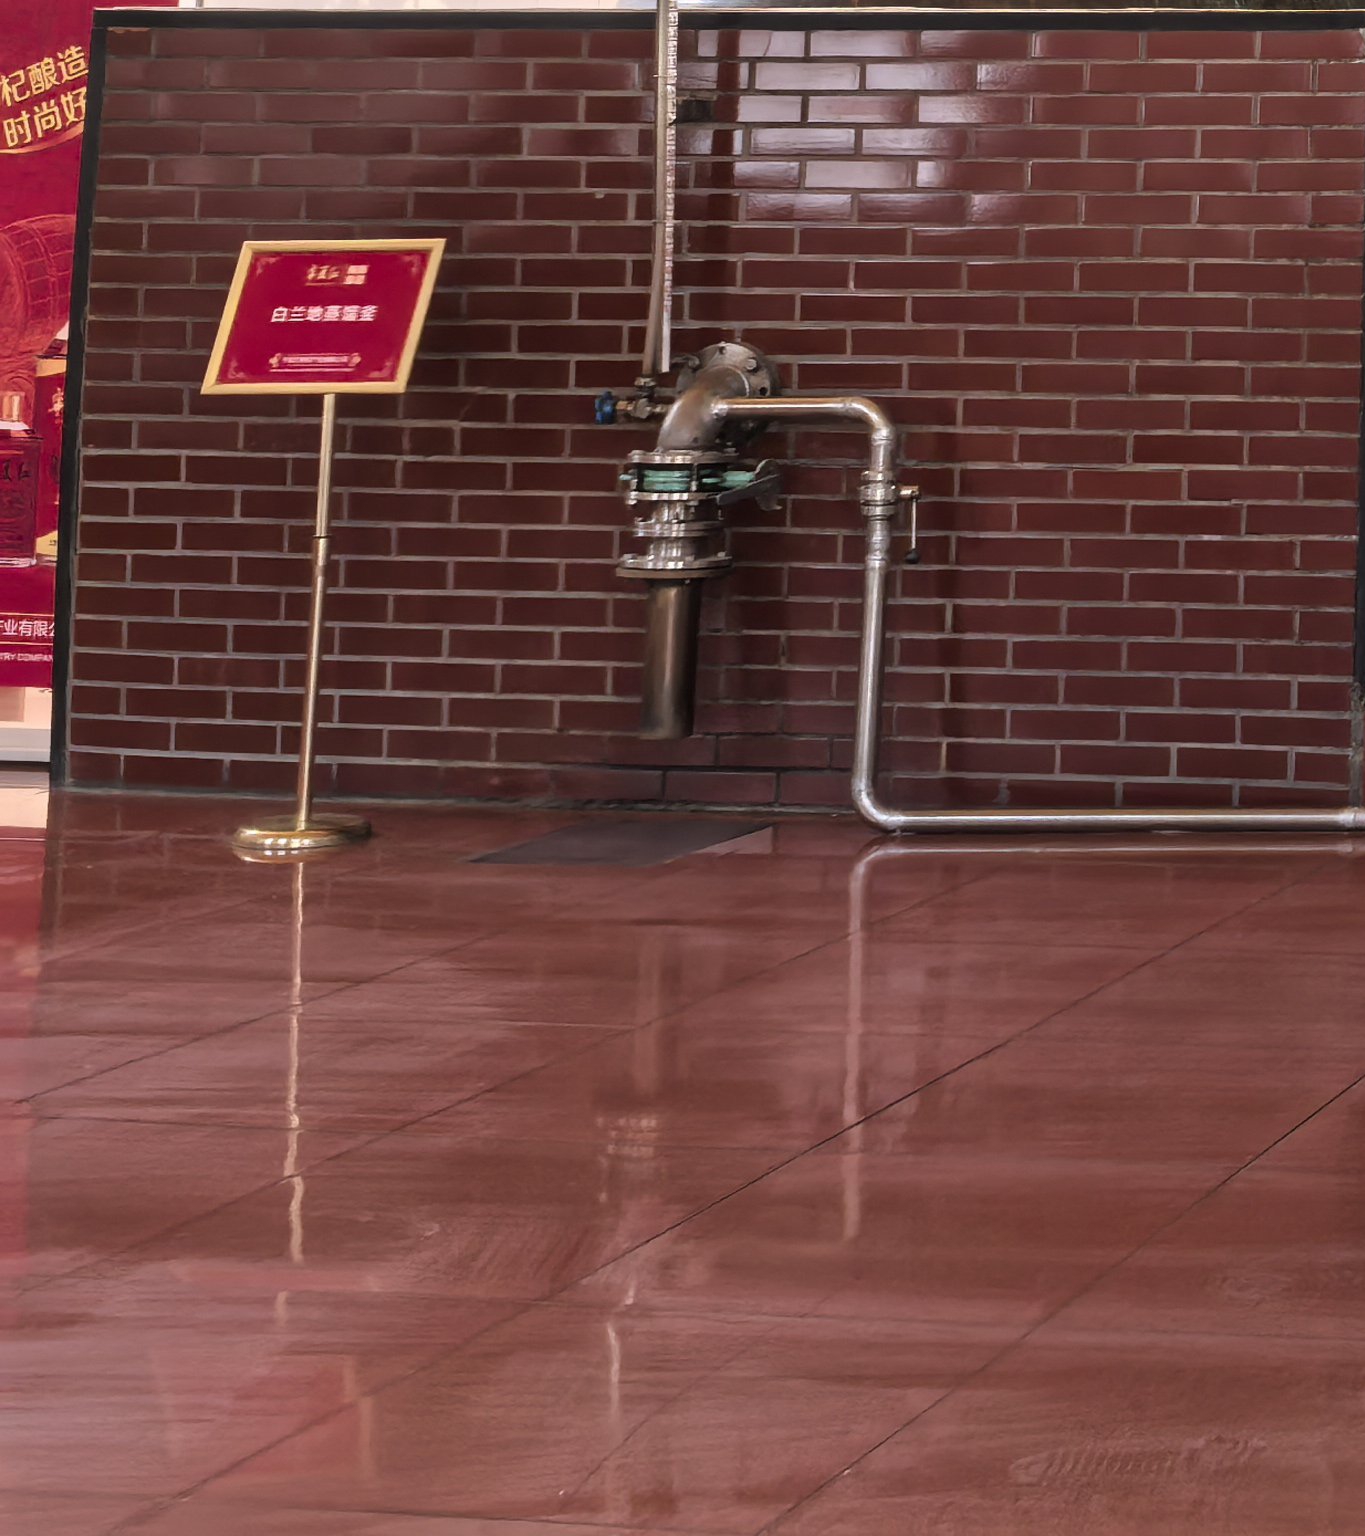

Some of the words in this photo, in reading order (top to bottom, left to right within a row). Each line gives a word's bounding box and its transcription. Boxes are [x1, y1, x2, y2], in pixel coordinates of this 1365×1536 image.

[0, 46, 89, 107] 杞酿造
[3, 86, 87, 148] 时尚好
